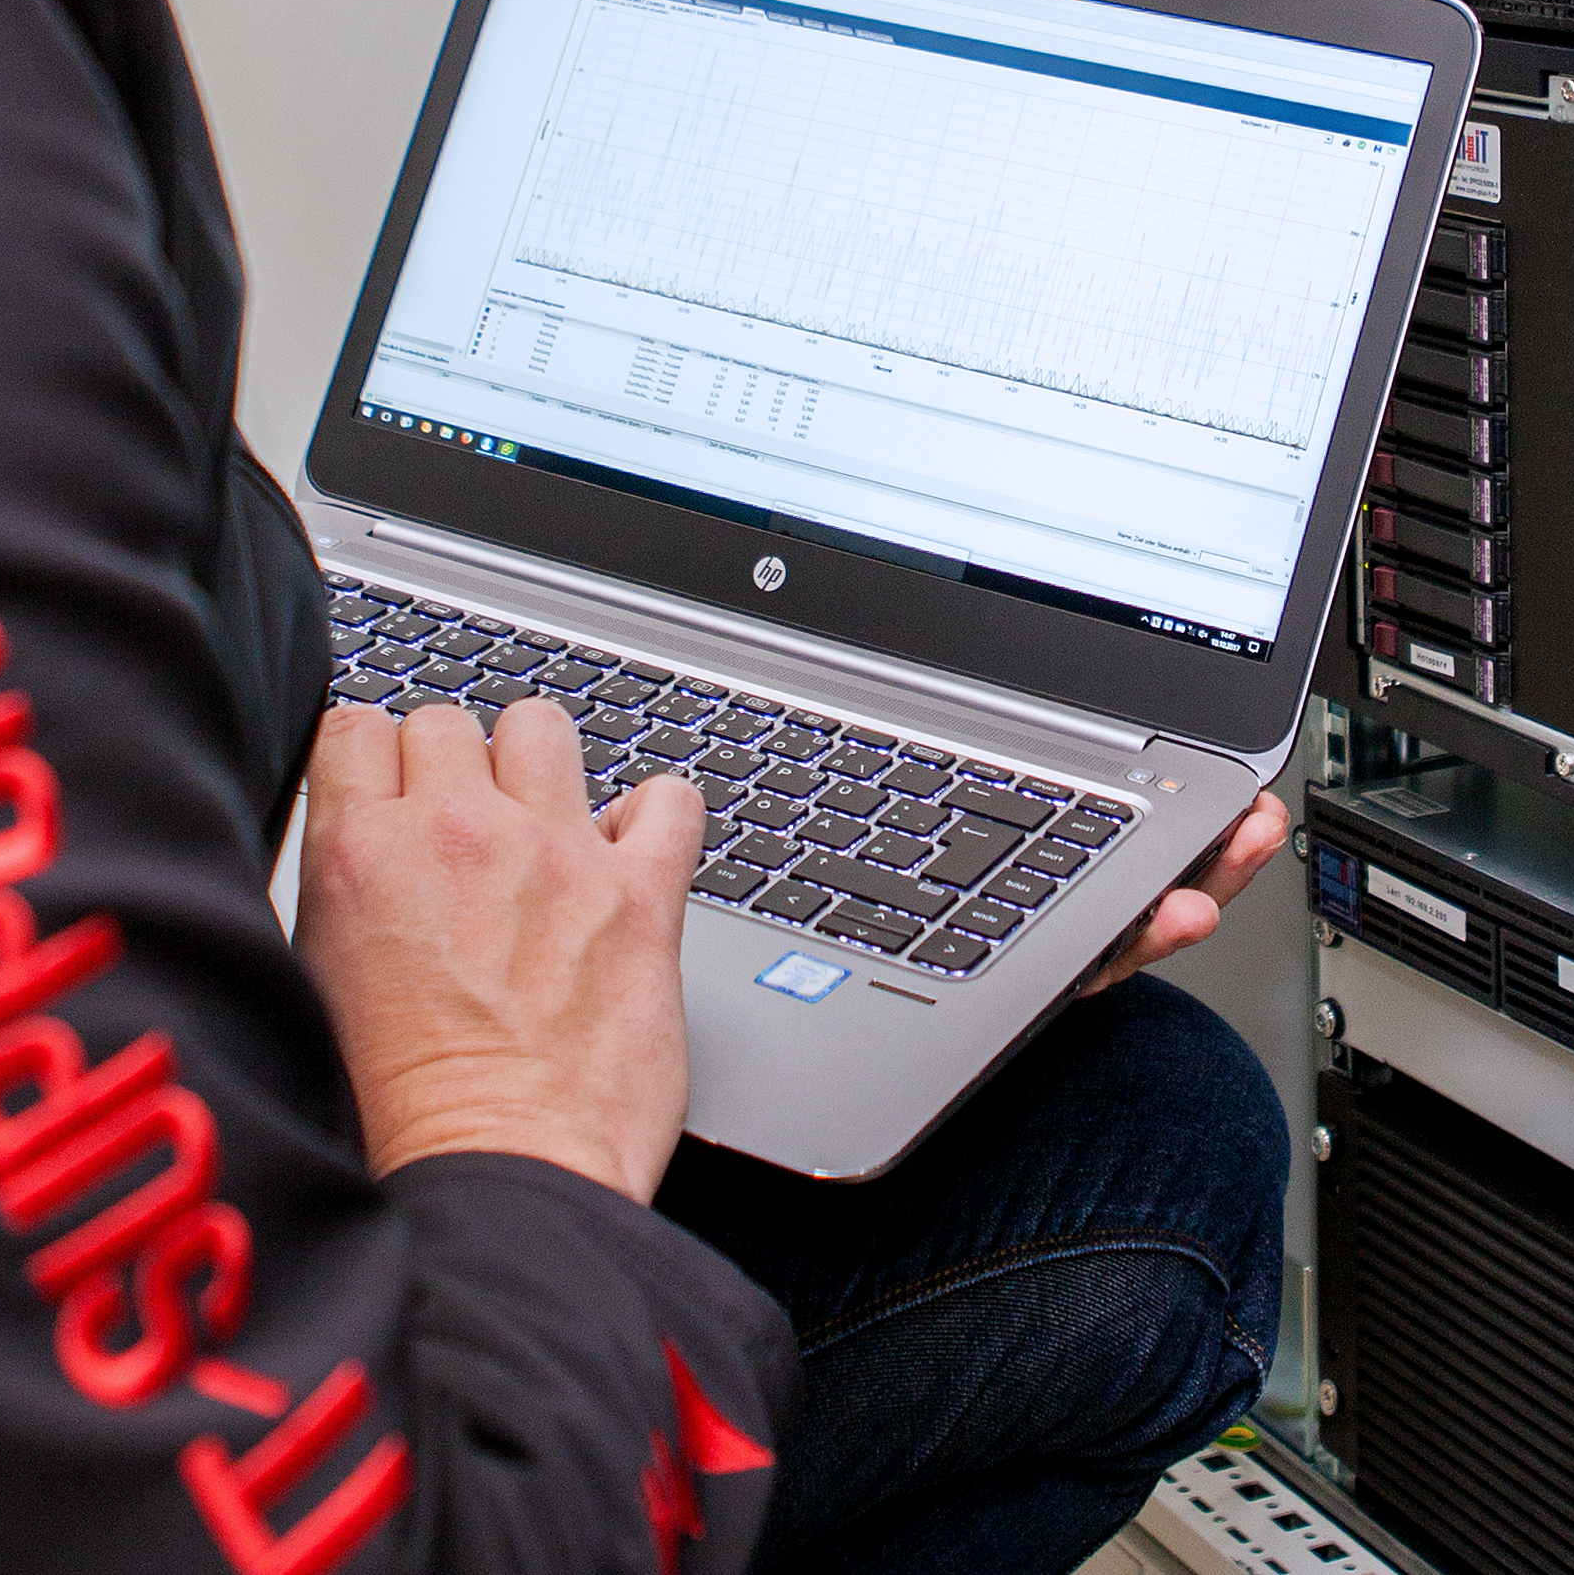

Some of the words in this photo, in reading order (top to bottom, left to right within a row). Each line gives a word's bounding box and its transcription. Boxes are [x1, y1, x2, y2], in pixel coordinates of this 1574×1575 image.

[753, 556, 787, 591] hp
[973, 764, 999, 776] einfg
[1031, 780, 1060, 794] druck
[1096, 800, 1119, 811] entf
[716, 867, 738, 880] strg
[971, 911, 999, 923] ende
